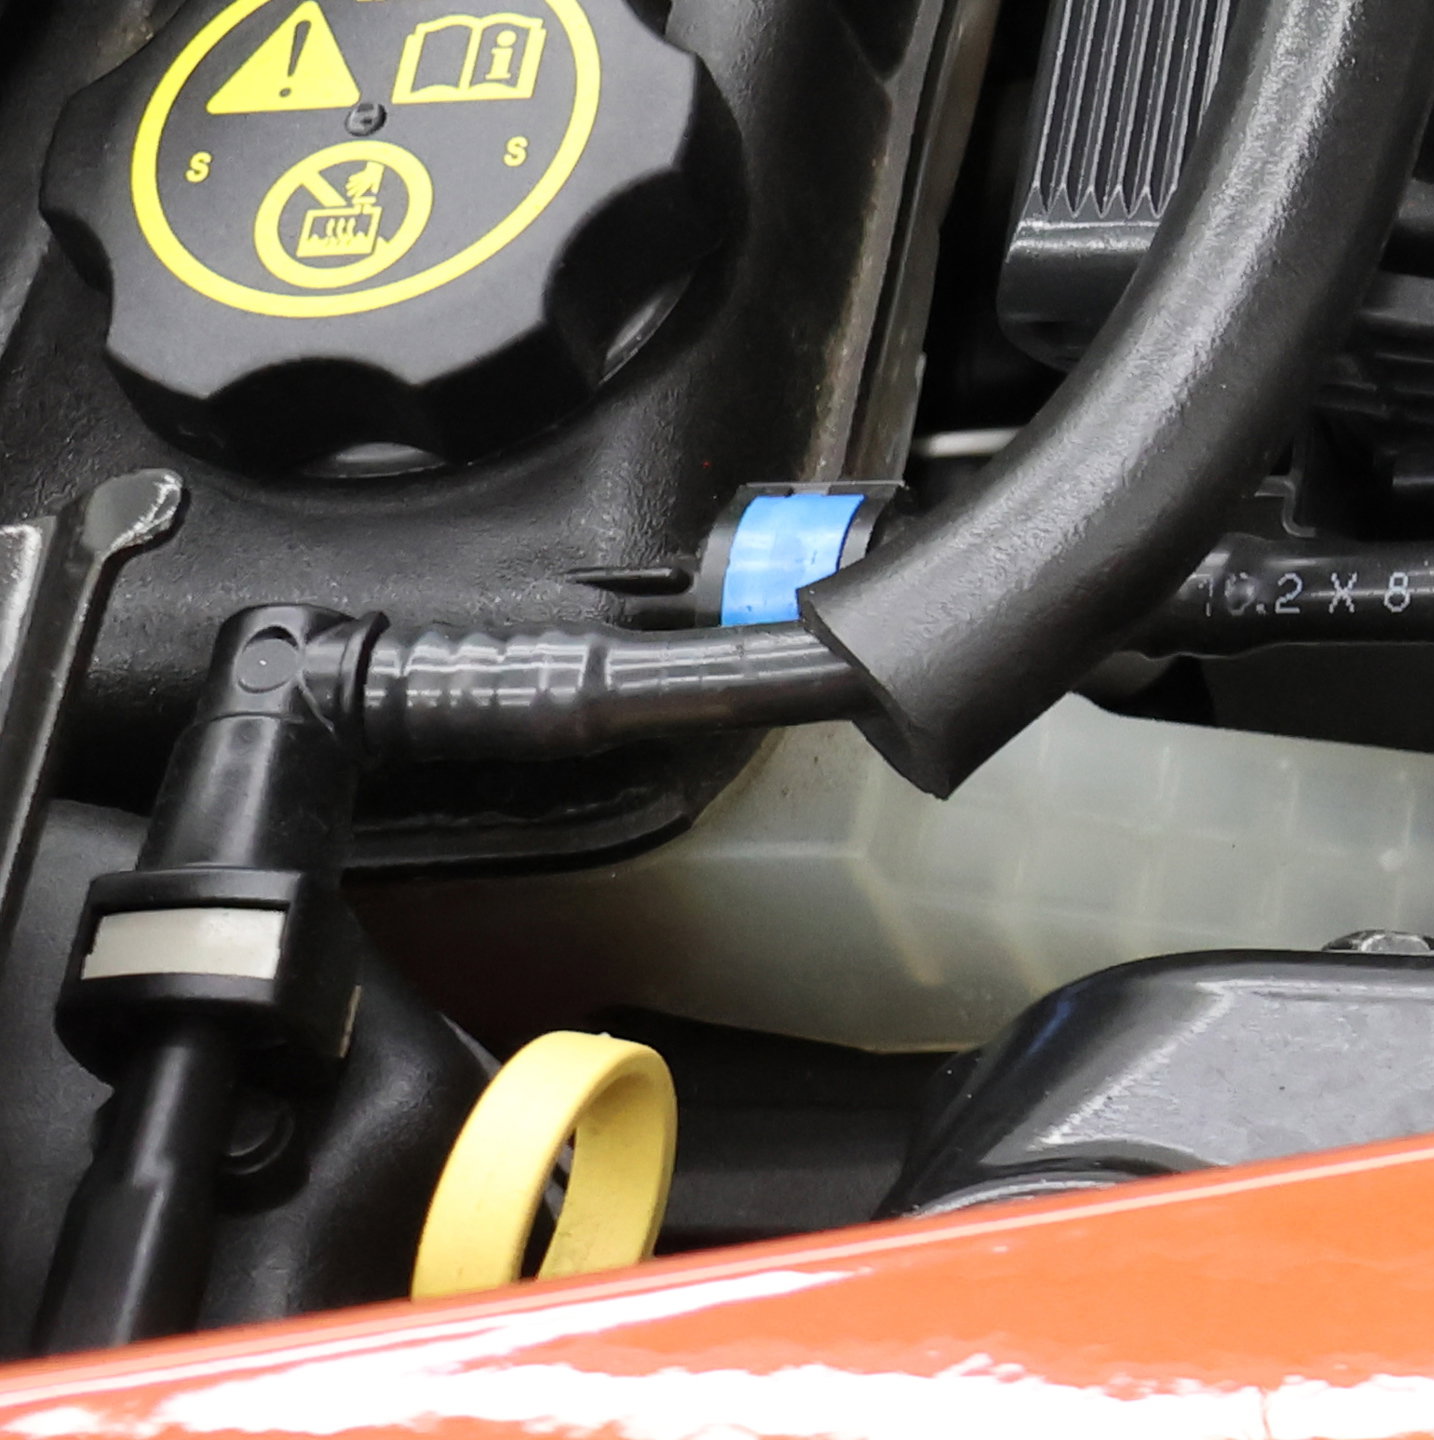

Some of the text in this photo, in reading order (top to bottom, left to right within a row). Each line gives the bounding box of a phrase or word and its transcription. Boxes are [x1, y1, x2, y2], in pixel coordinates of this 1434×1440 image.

[185, 152, 212, 183] S
[503, 137, 528, 167] S
[1328, 572, 1358, 614] X
[1384, 572, 1411, 613] 8
